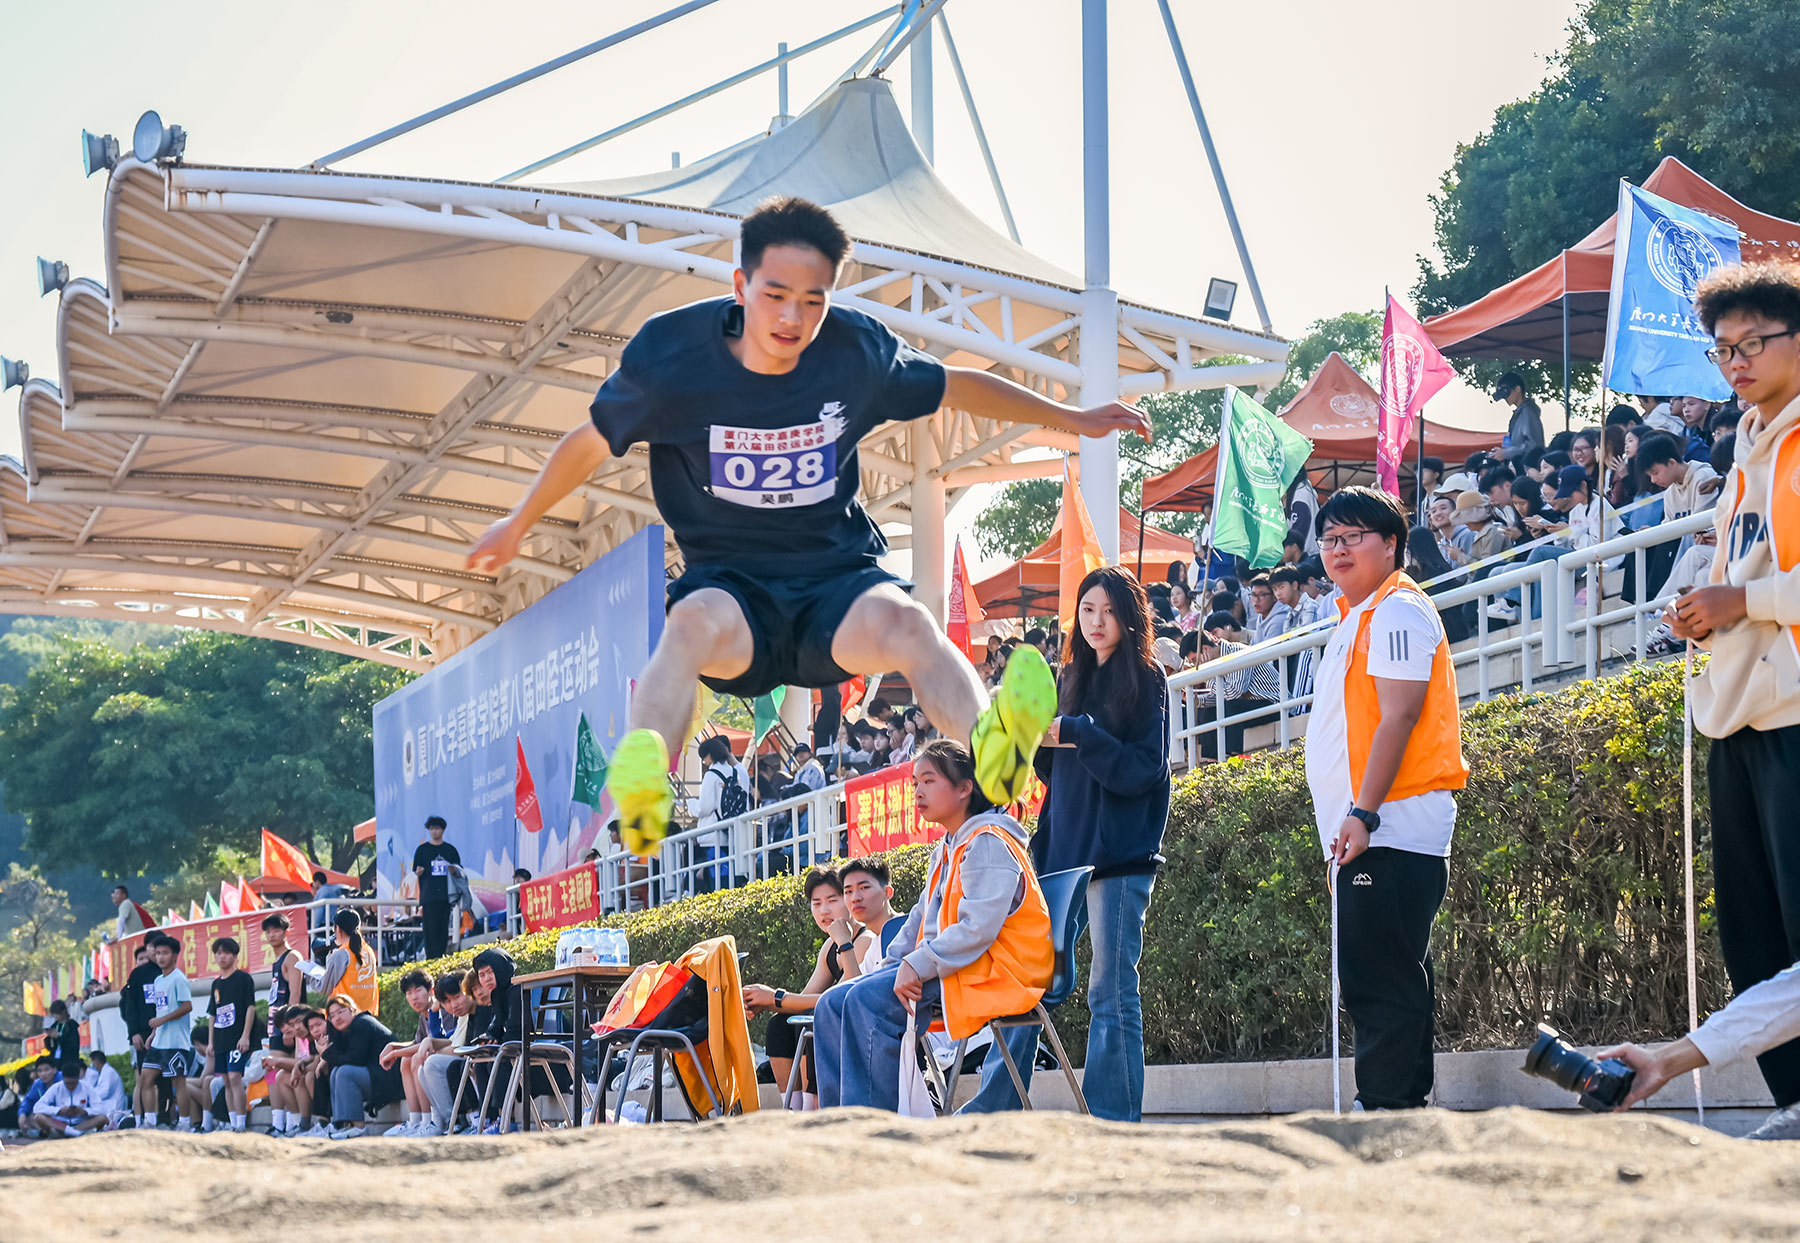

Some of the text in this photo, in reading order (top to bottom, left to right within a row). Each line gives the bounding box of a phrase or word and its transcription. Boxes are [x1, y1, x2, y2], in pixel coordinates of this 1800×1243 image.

[724, 424, 825, 441] 厦门大学嘉庚学院
[724, 435, 825, 451] 第八届田径运动会
[724, 451, 825, 488] 028
[417, 625, 600, 778] 厦门大学嘉庚学院第八届田径运动会
[228, 1049, 242, 1063] 19
